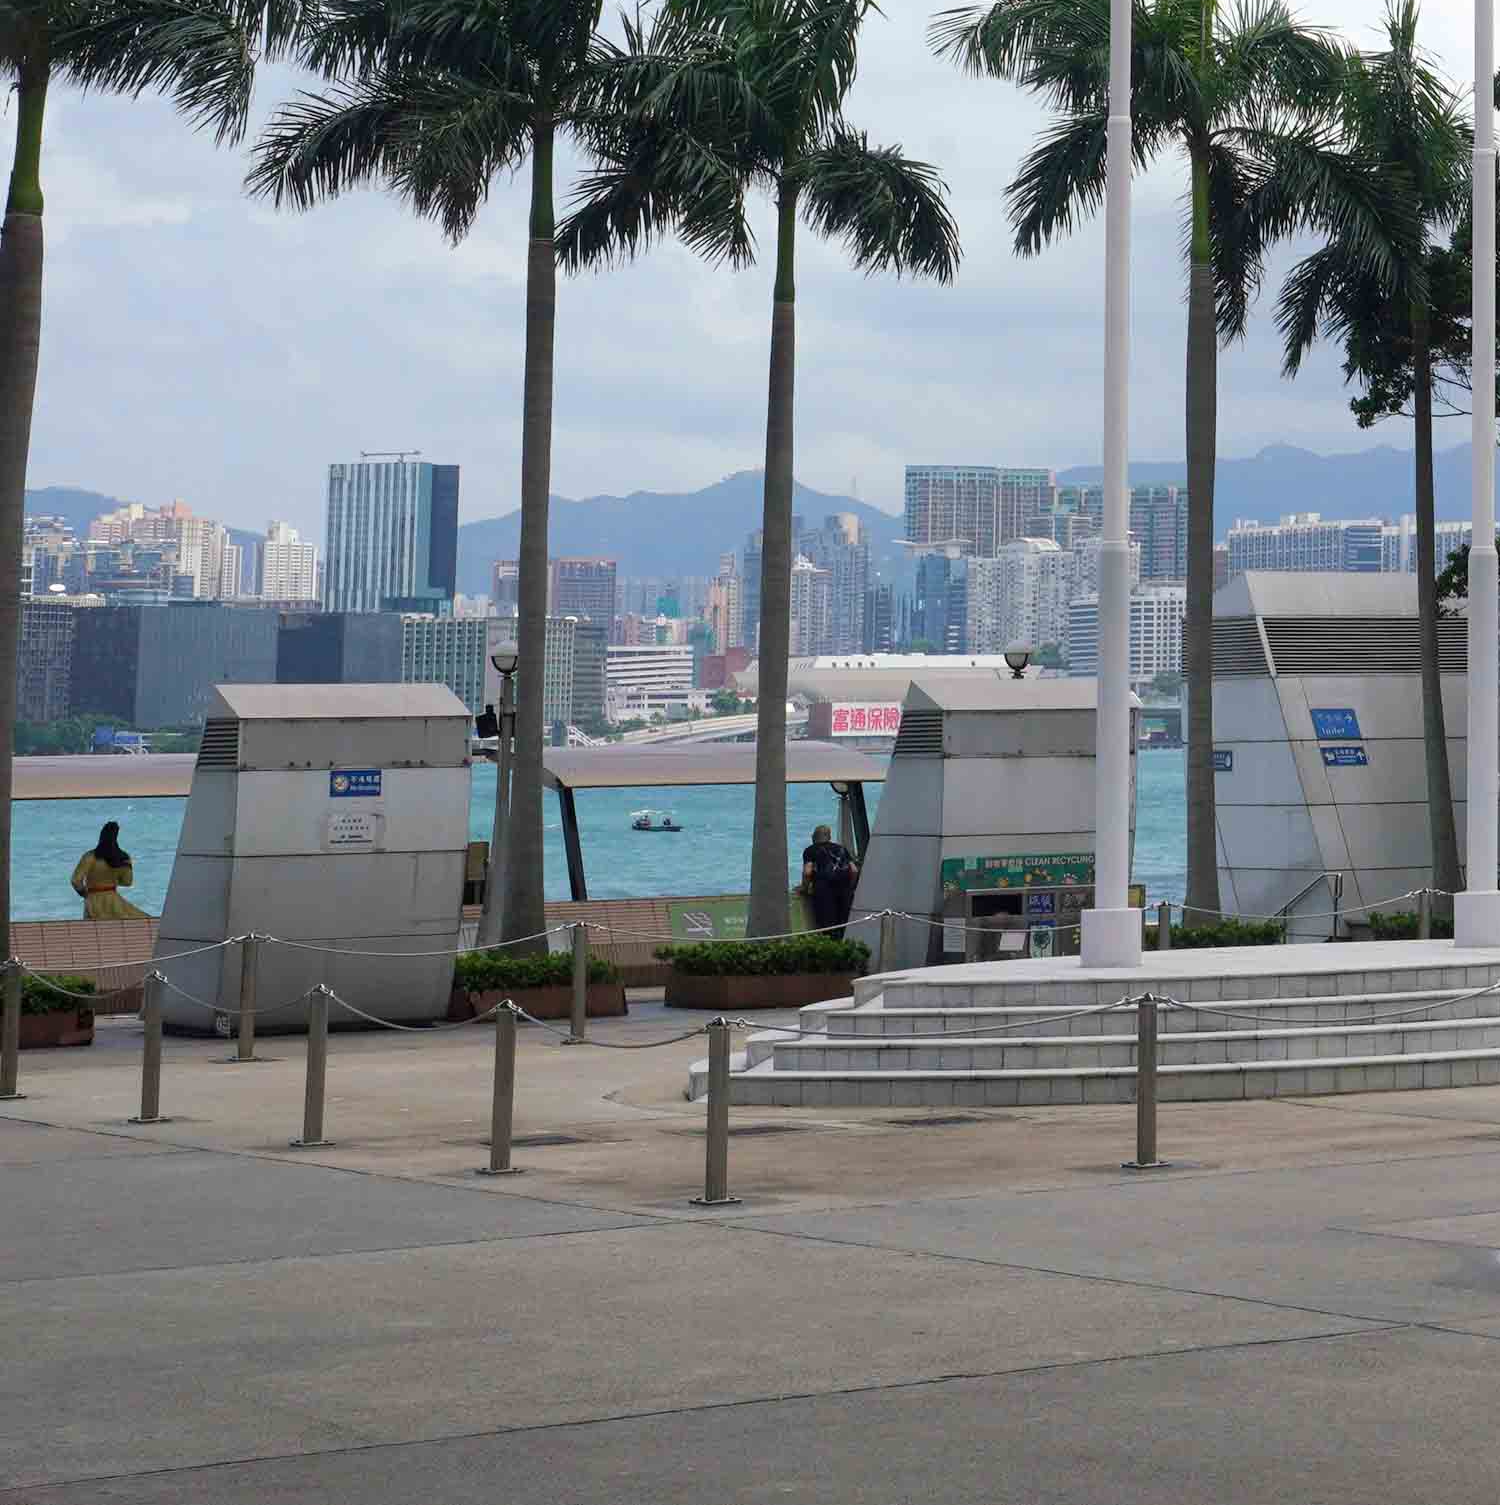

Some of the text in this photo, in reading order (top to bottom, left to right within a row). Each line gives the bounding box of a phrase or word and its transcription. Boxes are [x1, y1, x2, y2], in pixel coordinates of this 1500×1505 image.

[833, 708, 898, 731] 富通保險
[1024, 857, 1050, 865] CLEAN
[1051, 855, 1095, 865] RECYCLING
